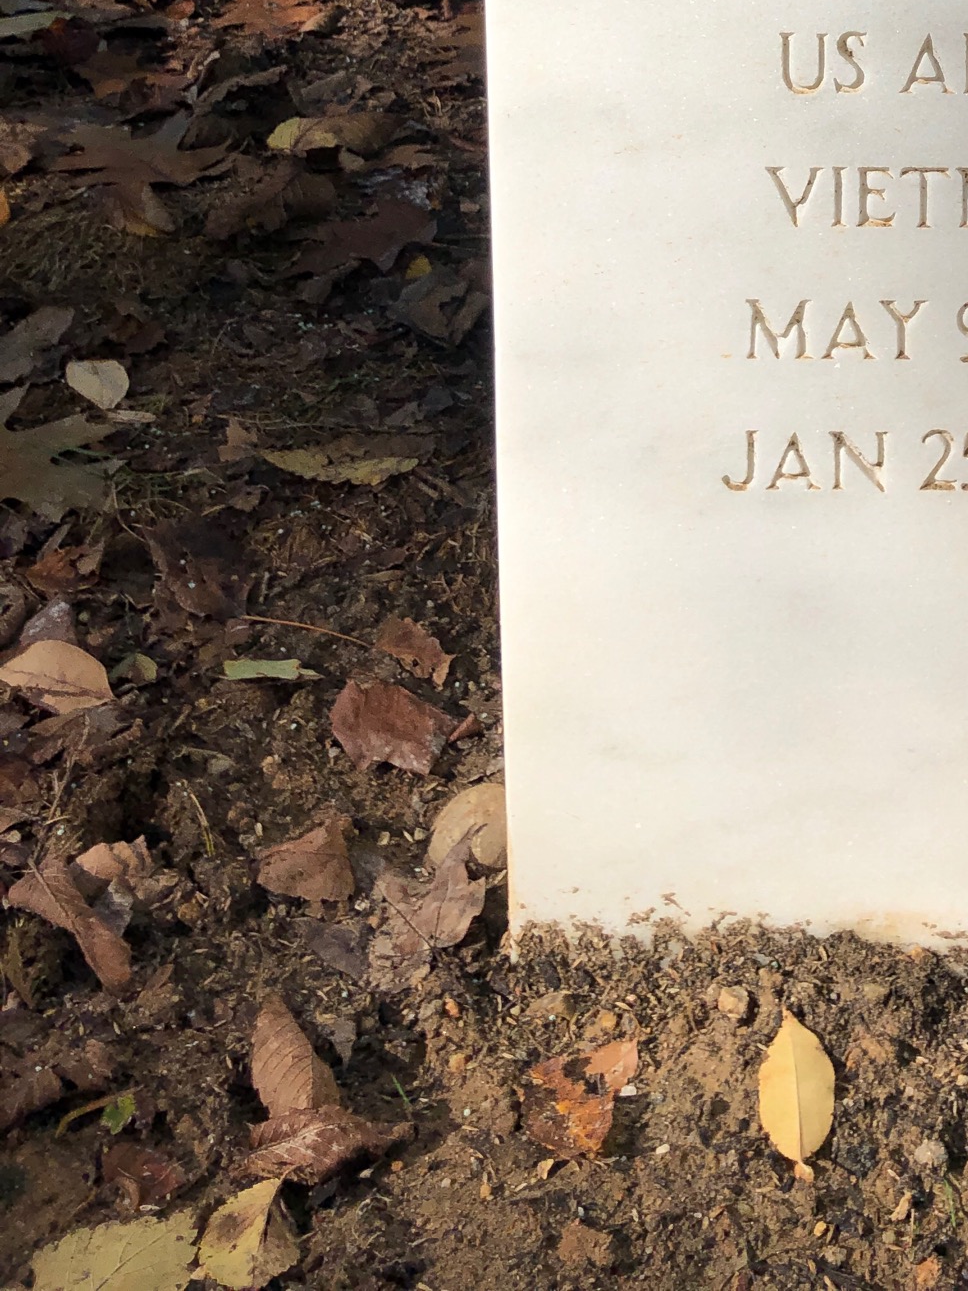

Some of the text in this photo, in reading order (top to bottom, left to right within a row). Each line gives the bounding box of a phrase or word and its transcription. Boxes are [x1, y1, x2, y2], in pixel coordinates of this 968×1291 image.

[779, 31, 867, 94] US
[745, 298, 928, 360] MAY
[721, 429, 888, 493] JAN
